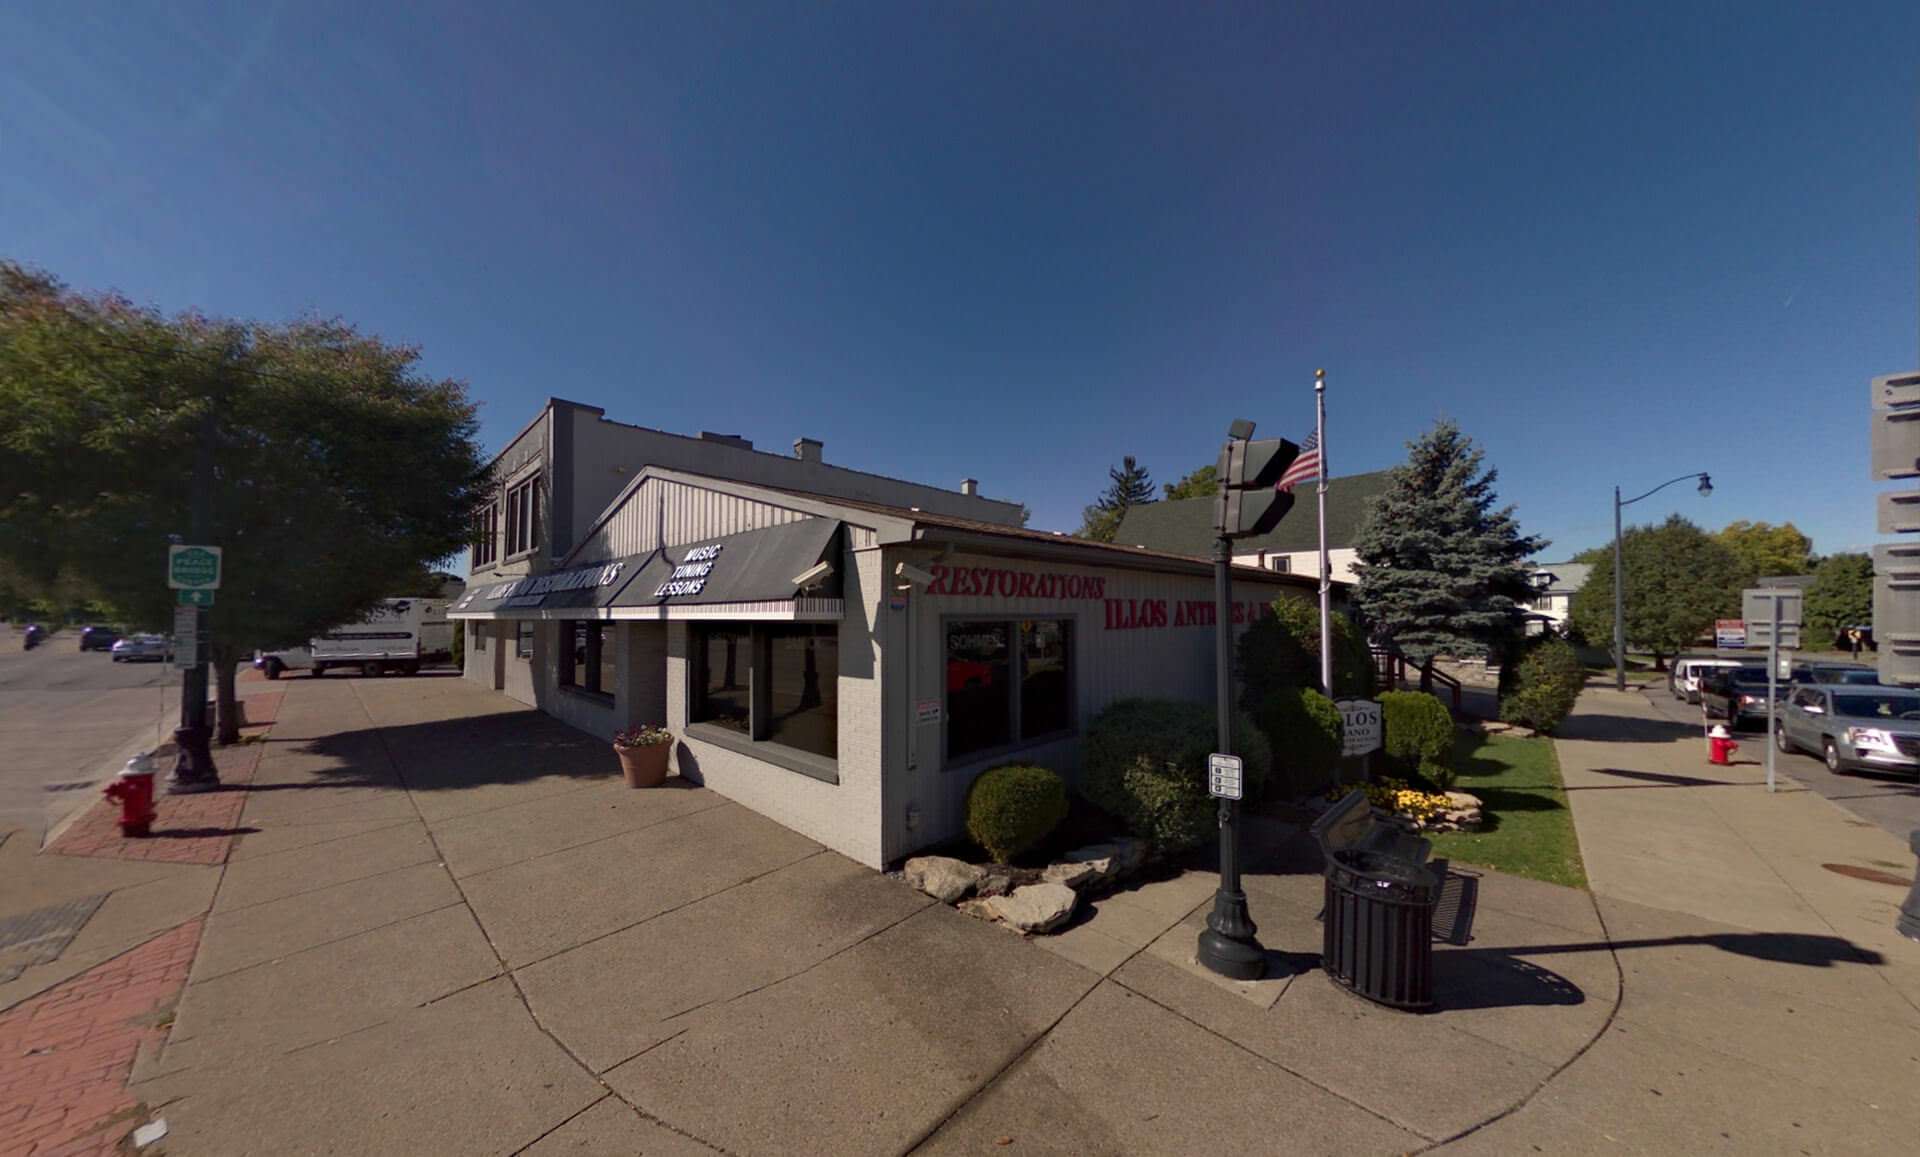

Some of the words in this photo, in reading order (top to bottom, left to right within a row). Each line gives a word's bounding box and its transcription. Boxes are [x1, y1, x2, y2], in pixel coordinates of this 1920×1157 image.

[683, 545, 721, 561] MUSIC
[671, 562, 712, 578] TUNING
[654, 580, 704, 596] LESSONS
[926, 563, 1106, 600] RESTORATIONS
[1104, 598, 1168, 630] ILLOS
[1345, 711, 1377, 727] LOS
